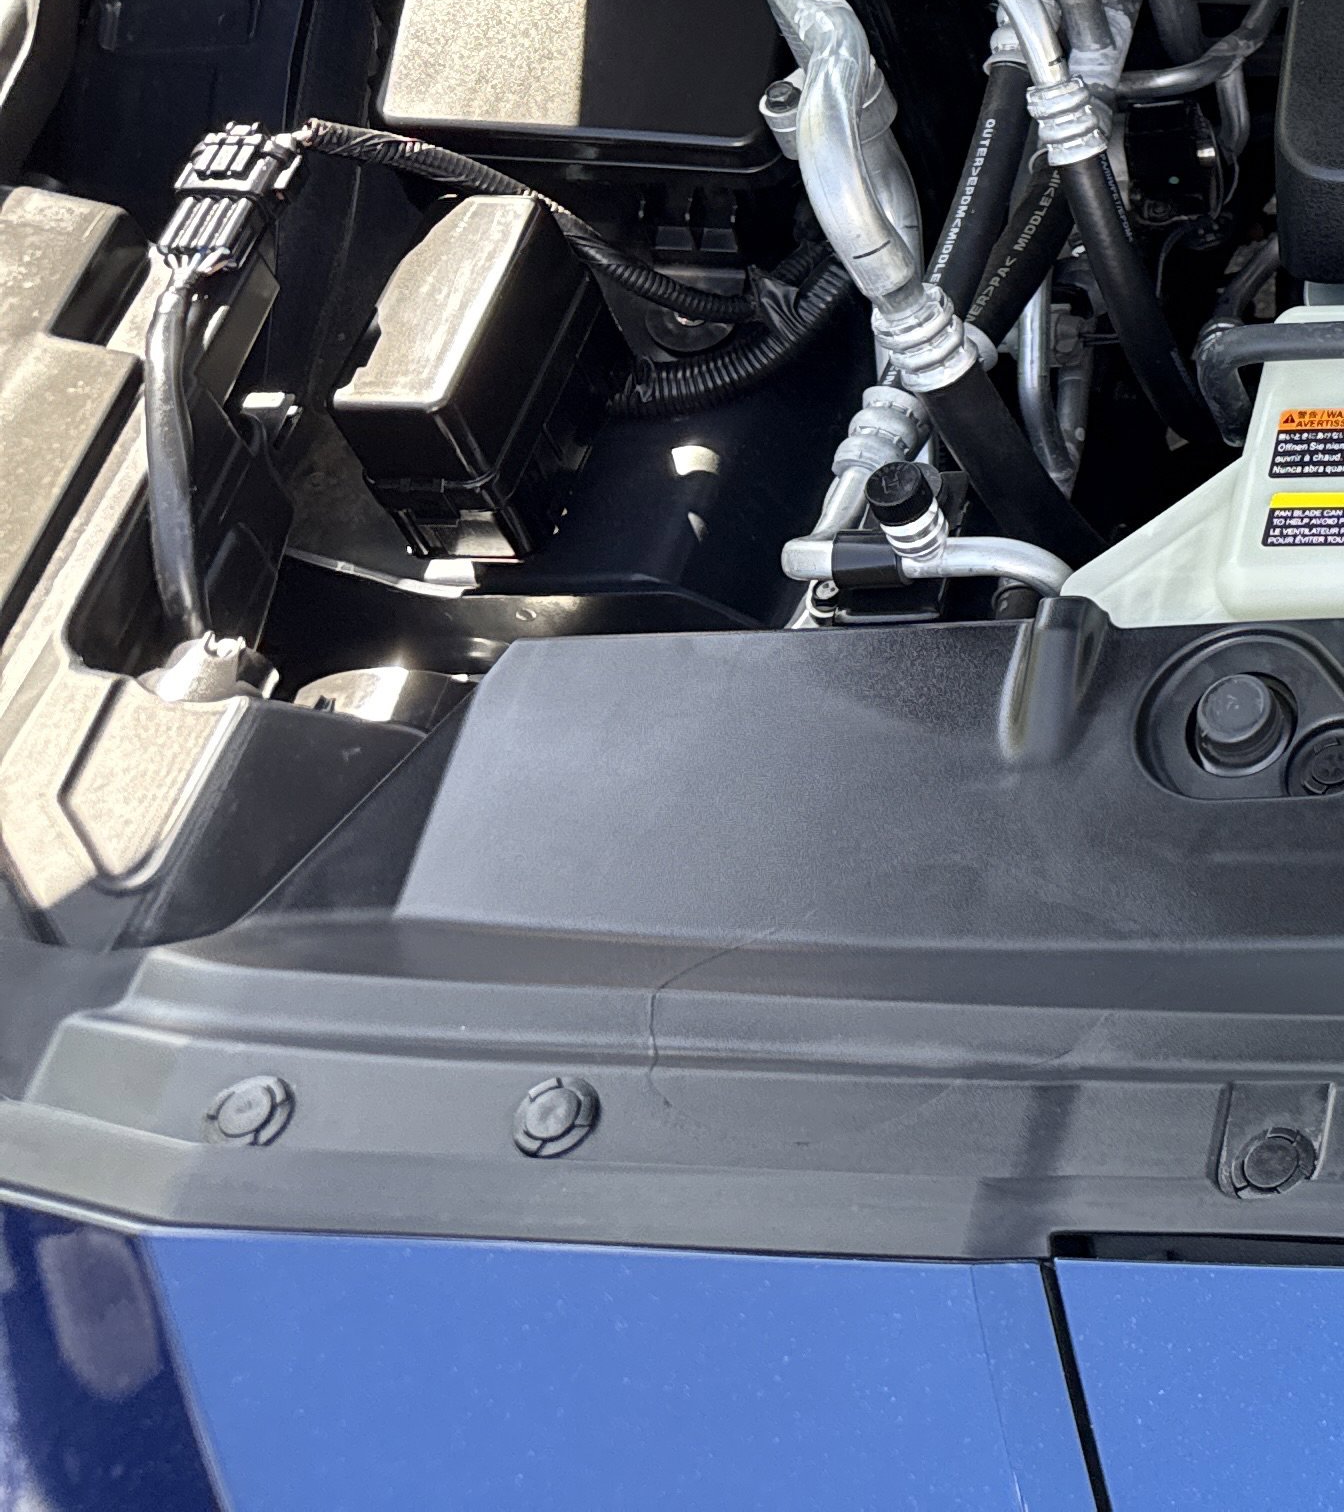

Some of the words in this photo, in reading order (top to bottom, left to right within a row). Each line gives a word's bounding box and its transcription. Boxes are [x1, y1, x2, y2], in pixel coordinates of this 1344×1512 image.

[1309, 442, 1325, 450] Sie
[1274, 454, 1302, 463] ouvrir
[1272, 465, 1302, 474] Nunca
[1303, 465, 1325, 473] abra
[1274, 509, 1293, 517] FAN
[1292, 509, 1322, 517] BLADE
[1323, 509, 1344, 517] CAN
[1273, 518, 1285, 526] TO
[1269, 528, 1282, 536] LE
[1282, 527, 1339, 536] VENTILATEUR
[1267, 536, 1294, 545] POUR
[1295, 534, 1325, 544] ÉVITER
